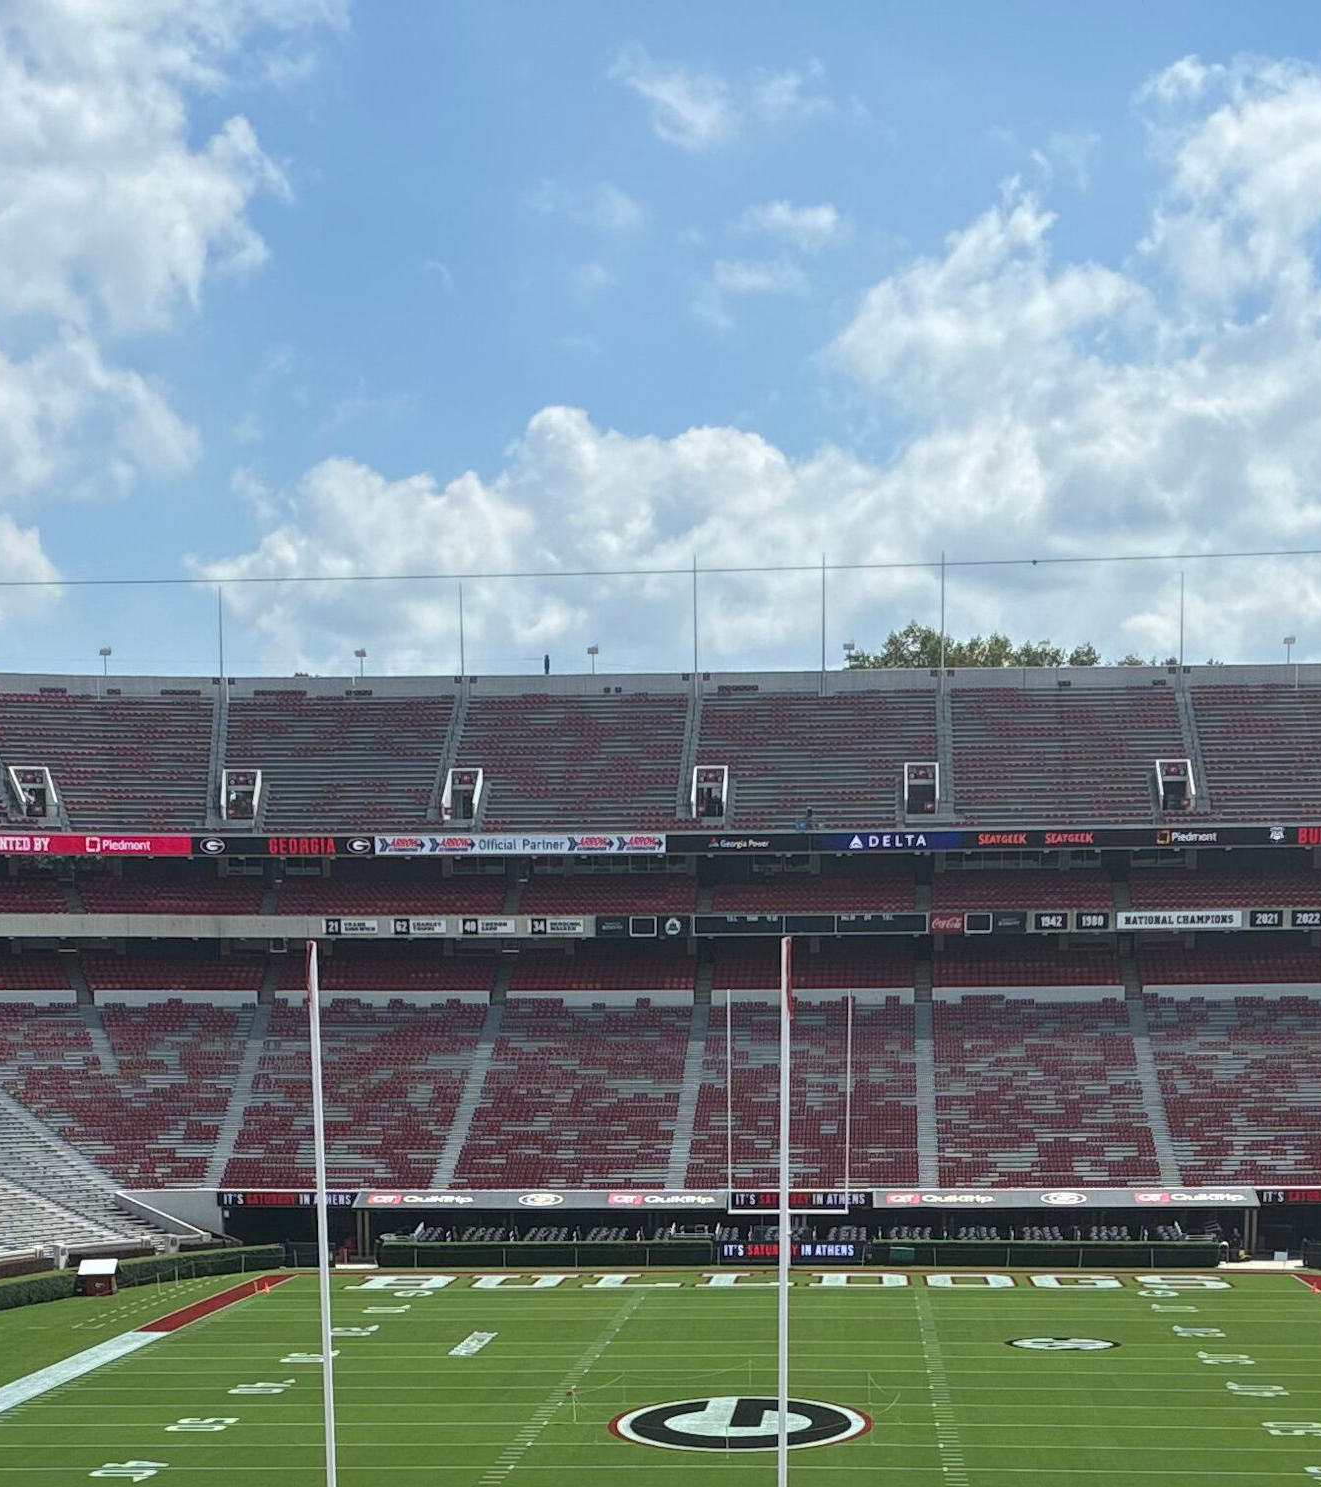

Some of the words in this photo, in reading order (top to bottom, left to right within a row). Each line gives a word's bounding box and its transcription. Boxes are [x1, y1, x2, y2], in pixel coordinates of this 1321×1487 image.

[868, 834, 927, 848] DELTA
[978, 833, 1027, 845] SEATGEEK
[1044, 832, 1094, 844] SEATGEEK
[1171, 831, 1217, 842] Piedmont
[33, 837, 51, 852] BY
[102, 839, 151, 852] Piedmont
[268, 838, 336, 855] GEORGIA
[478, 839, 517, 851] Official
[523, 839, 565, 851] Partner
[720, 839, 747, 849] Georgia
[748, 839, 770, 848] Power
[1040, 915, 1063, 927] 1942
[1081, 914, 1105, 927] 1980
[1124, 914, 1174, 925] NATIONAL
[1177, 913, 1234, 925] CHAMPIONS
[1255, 913, 1279, 925] 2021
[1296, 913, 1321, 925] 2022
[327, 920, 340, 932] 21
[532, 920, 545, 932] 34
[735, 1193, 756, 1205] IT'S
[812, 1193, 823, 1205] IN
[1263, 1191, 1284, 1203] IT'S
[723, 1244, 744, 1257] IT'S
[801, 1244, 813, 1257] IN
[815, 1244, 854, 1257] ATHENS
[164, 1417, 240, 1432] 50
